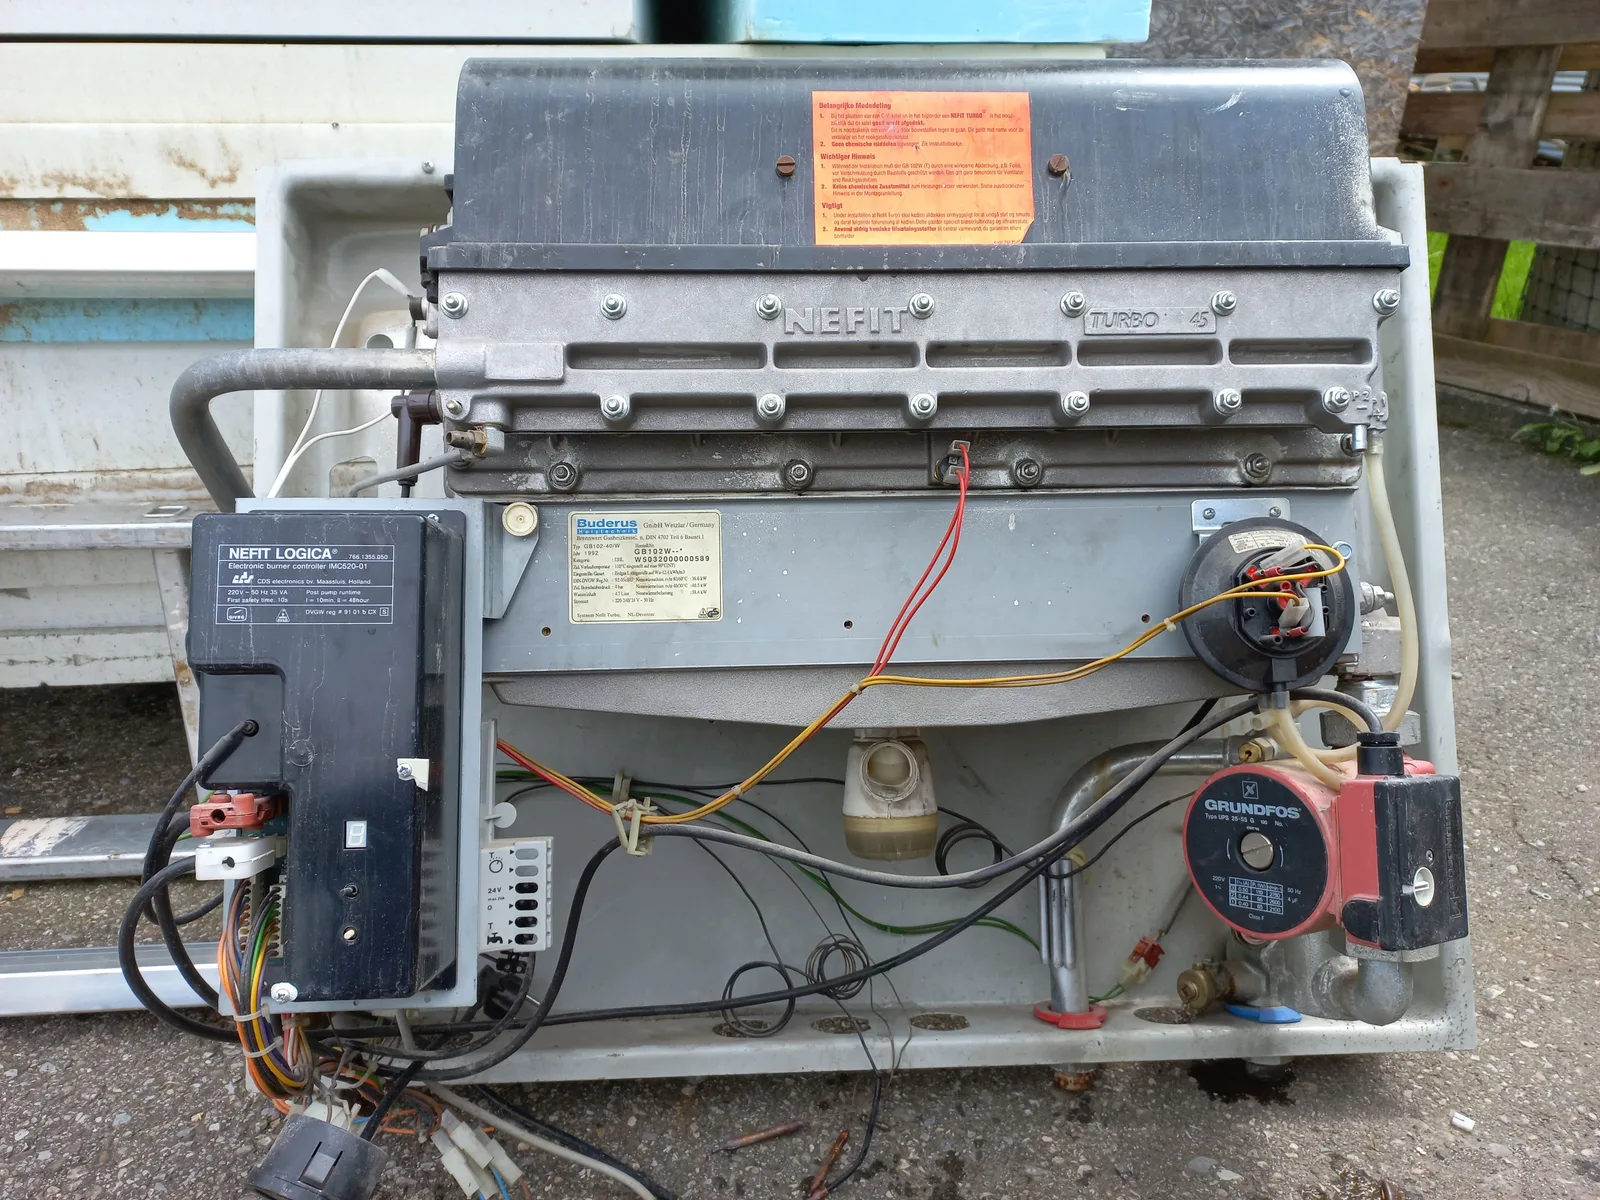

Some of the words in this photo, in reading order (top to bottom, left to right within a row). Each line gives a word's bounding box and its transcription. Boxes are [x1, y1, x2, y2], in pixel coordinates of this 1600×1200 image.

[784, 307, 908, 334] NEFIT
[1090, 312, 1160, 328] TURBO
[1189, 311, 1209, 328] 45
[577, 518, 637, 527] Buderus
[229, 548, 272, 560] NEFIT
[1204, 799, 1300, 819] GRUNDFOS
